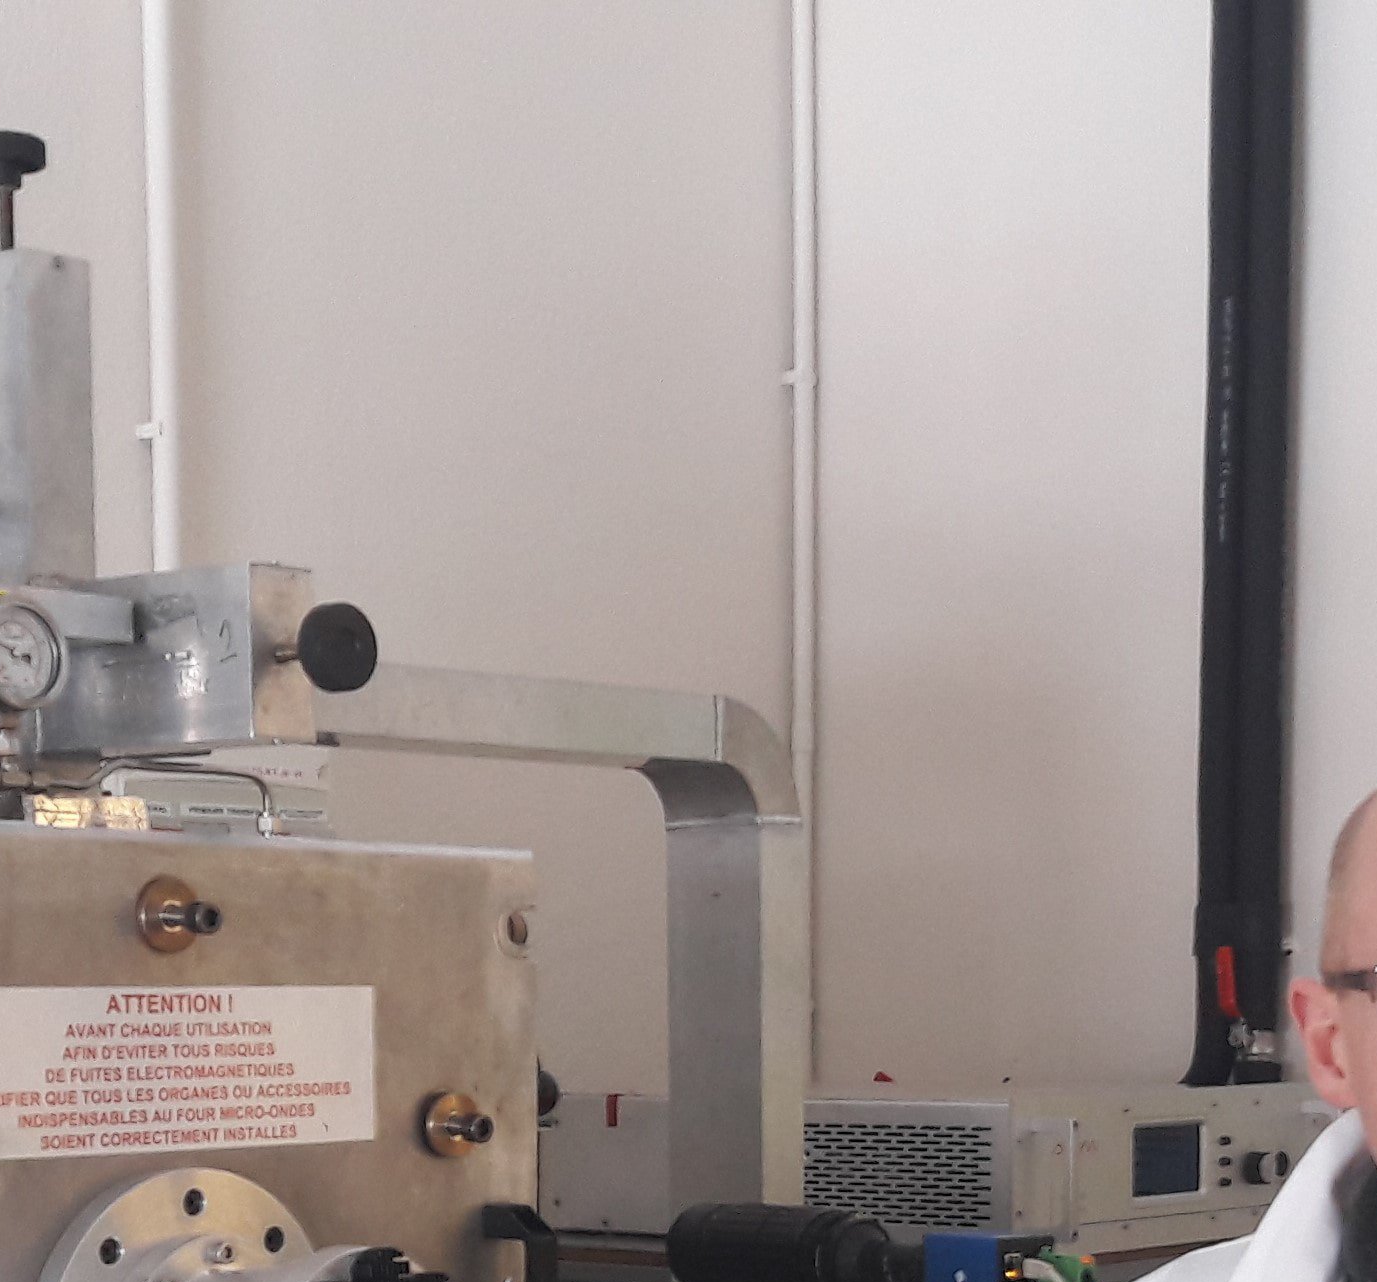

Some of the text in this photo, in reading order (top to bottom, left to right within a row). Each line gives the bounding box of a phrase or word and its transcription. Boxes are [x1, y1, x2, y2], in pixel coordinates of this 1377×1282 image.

[106, 994, 232, 1014] ATTENTION !
[66, 1022, 272, 1038] AVANT CHAQUE UTILISATION
[63, 1043, 275, 1062] AFIN D'EVITER TOUS RISQUES
[45, 1063, 294, 1083] DE FUITES ELECTROMAGNETIQUES
[45, 1091, 76, 1105] QUE
[82, 1089, 122, 1104] TOUS
[127, 1088, 153, 1102] LES
[159, 1086, 227, 1101] ORGANES
[233, 1085, 251, 1099] OU
[257, 1082, 351, 1096] ACCESSOIRES
[19, 1103, 314, 1127] INDISPENSABLES AU FOUR MICRO-ONDES
[41, 1125, 296, 1149] SOIENT CORRECTEMENT INSTALLES
